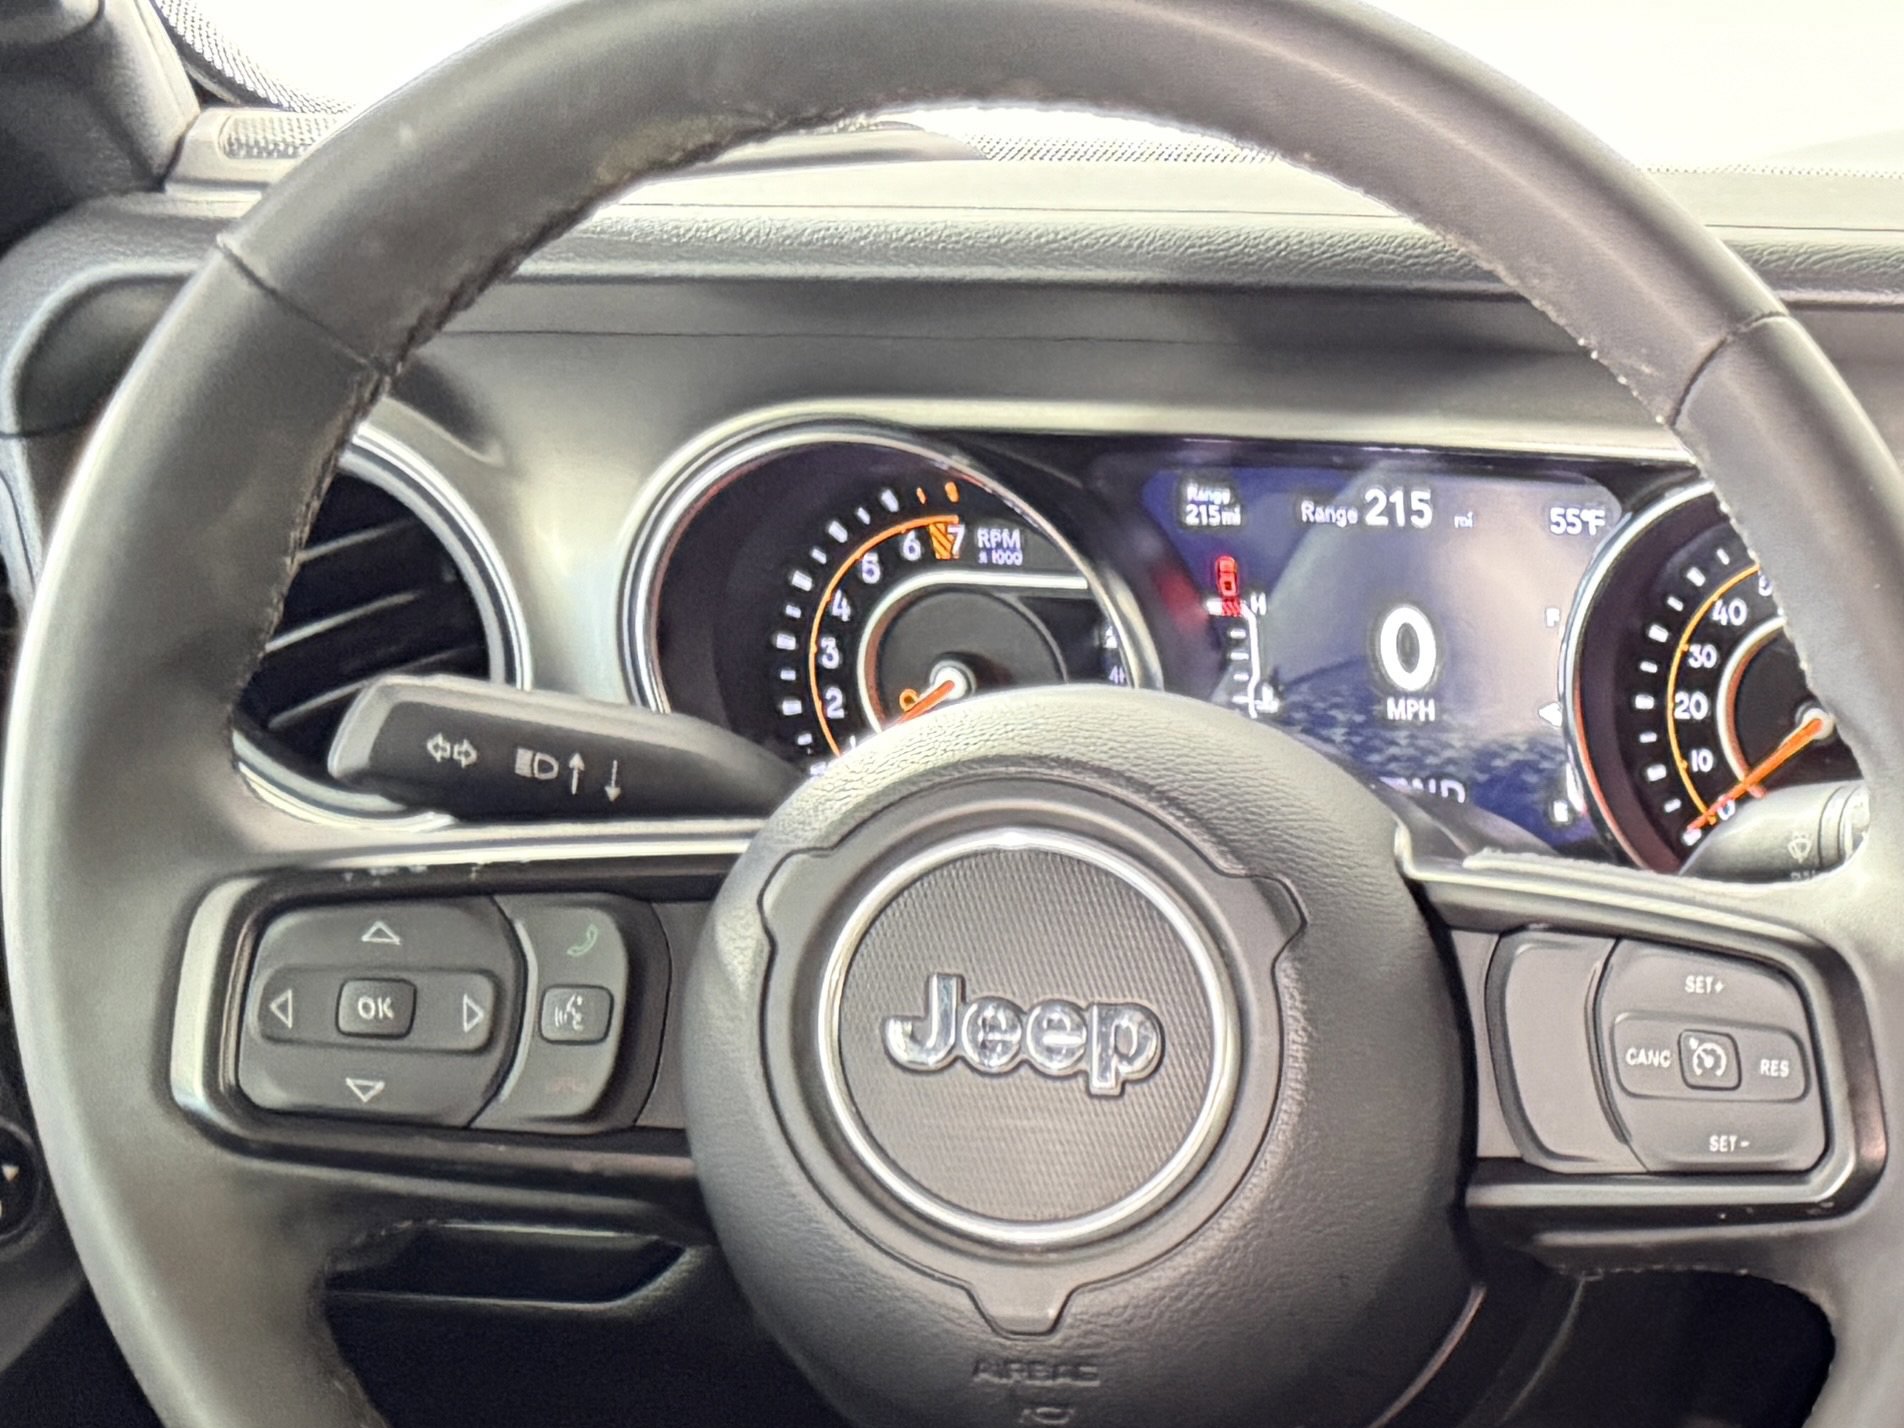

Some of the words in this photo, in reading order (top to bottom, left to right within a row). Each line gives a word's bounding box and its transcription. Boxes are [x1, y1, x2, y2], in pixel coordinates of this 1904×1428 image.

[1186, 484, 1231, 505] Range
[1301, 502, 1358, 525] Range
[1364, 488, 1432, 528] 215
[1454, 510, 1473, 529] mi
[901, 531, 922, 561] 6
[947, 523, 966, 552] 7
[977, 528, 1022, 549] RPM
[859, 552, 882, 585] 5
[830, 590, 852, 622] 4
[1711, 598, 1748, 627] 40
[820, 636, 840, 670] 3
[1379, 603, 1437, 692] 0
[1687, 644, 1718, 669] 30
[824, 687, 845, 720] 2
[1387, 698, 1435, 721] MPH
[1674, 691, 1710, 720] 20
[1690, 748, 1714, 772] 10
[356, 996, 394, 1021] OK
[883, 972, 1164, 1098] Jeep
[1625, 1047, 1673, 1068] CANC
[1759, 1059, 1790, 1078] RES
